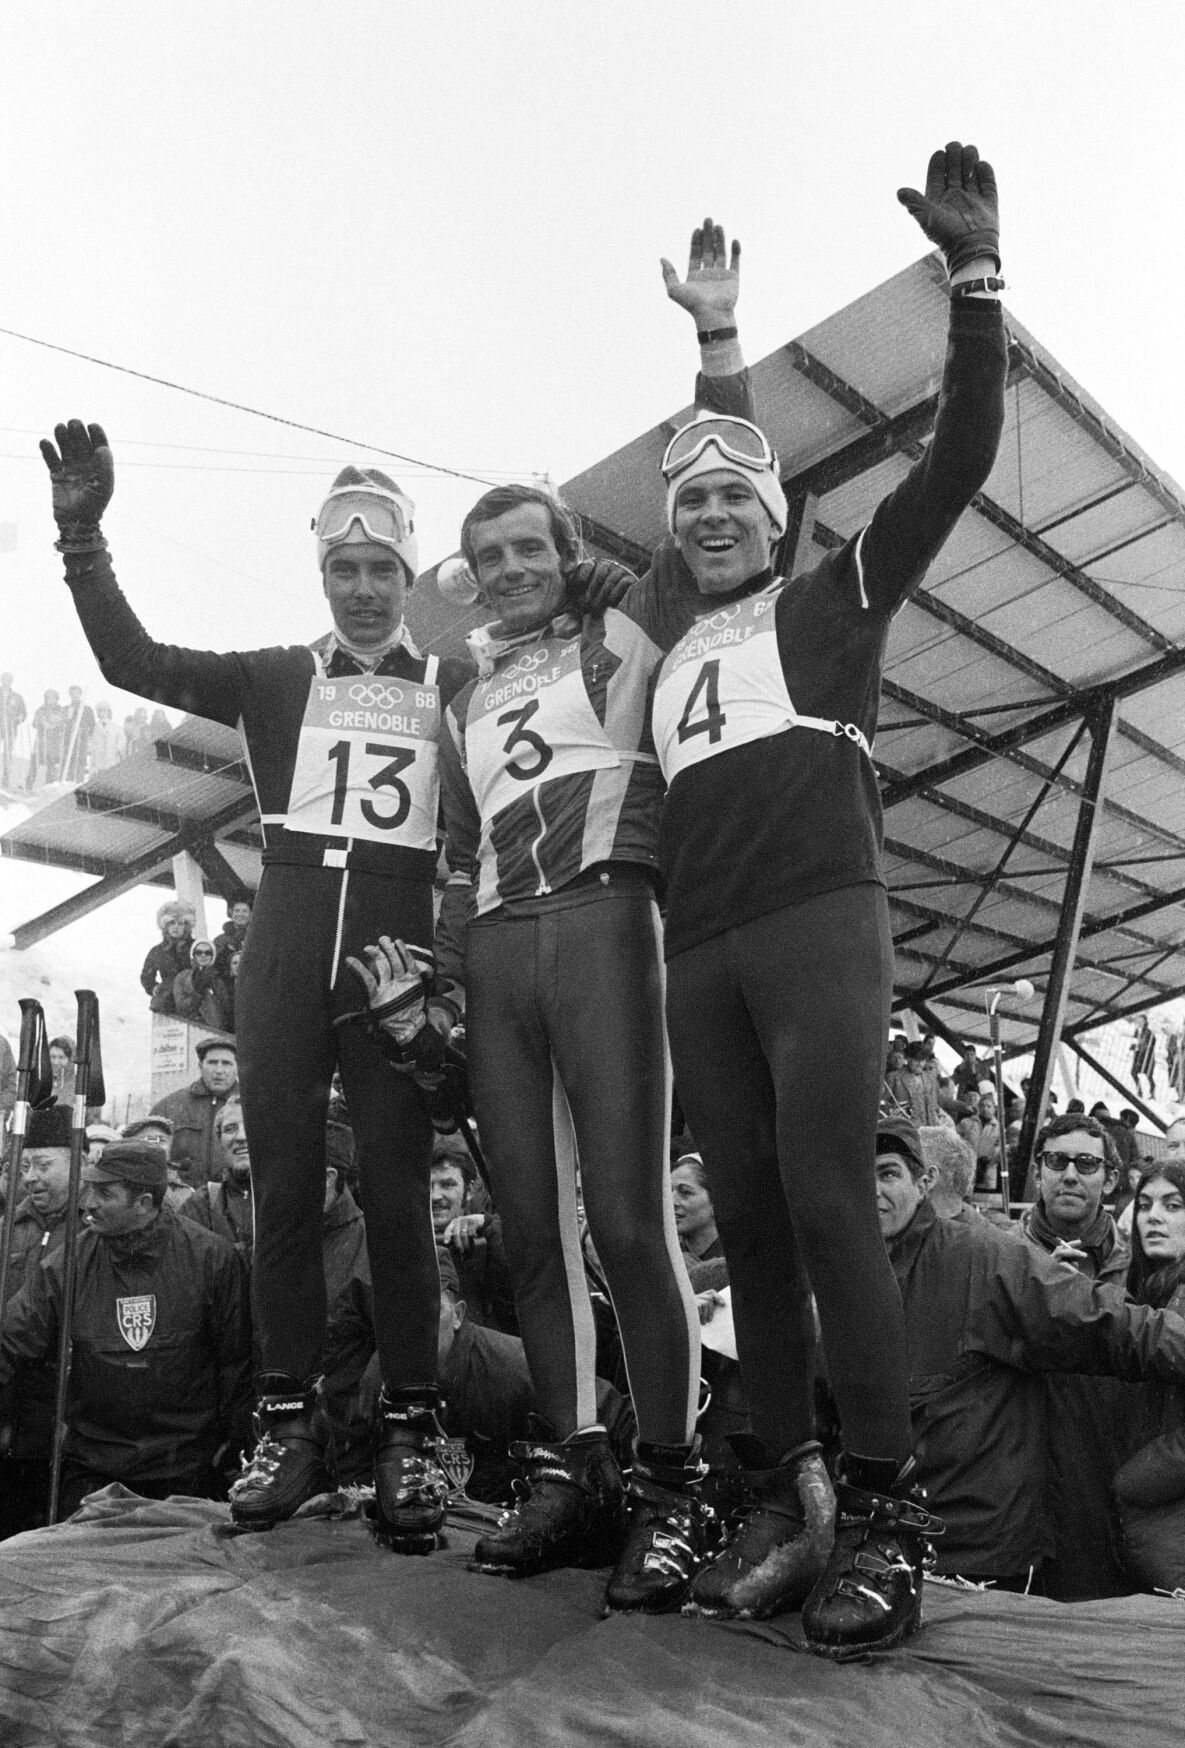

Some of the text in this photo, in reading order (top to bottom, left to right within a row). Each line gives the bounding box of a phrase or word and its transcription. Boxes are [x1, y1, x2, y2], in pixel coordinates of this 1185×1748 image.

[317, 685, 436, 709] 19 68
[677, 658, 726, 745] 4
[328, 710, 421, 735] GRENOBLE
[497, 698, 554, 781] 3
[327, 740, 416, 830] 13
[122, 1313, 152, 1328] CRS
[124, 1303, 149, 1314] POLICE
[266, 1401, 304, 1412] LANGE
[441, 1452, 471, 1465] CRS
